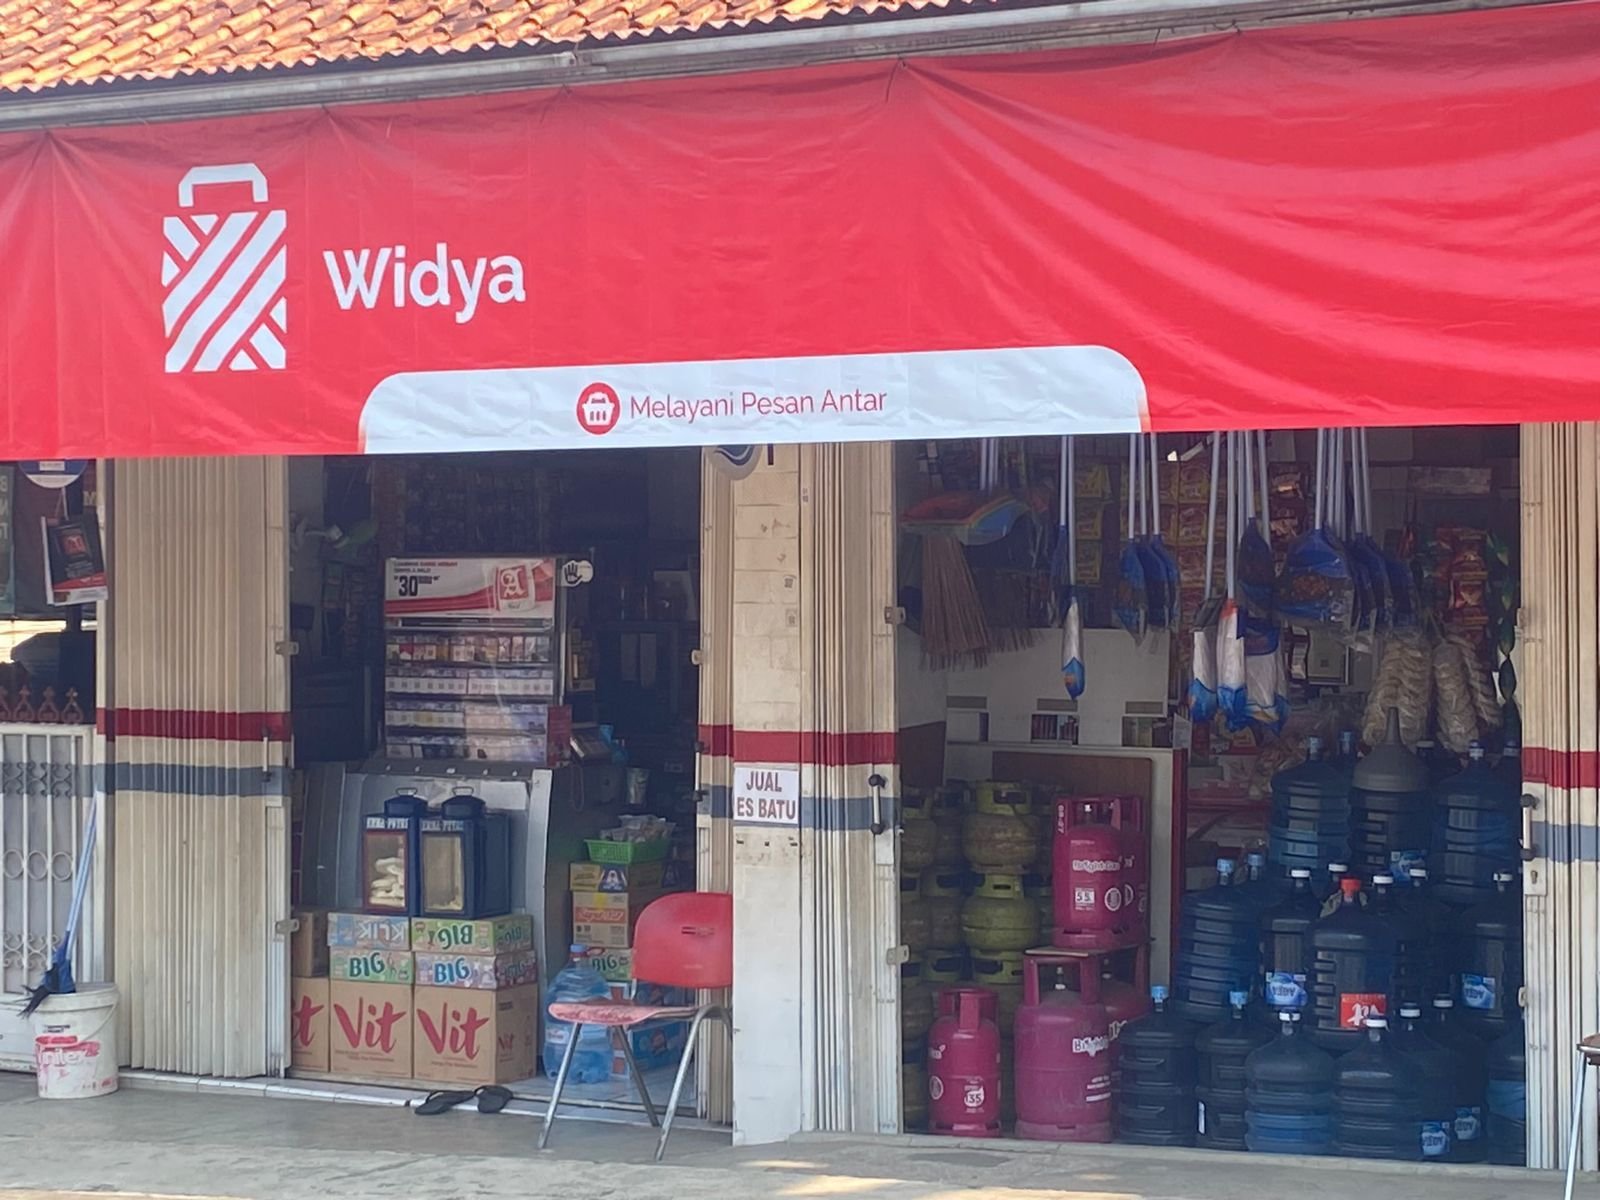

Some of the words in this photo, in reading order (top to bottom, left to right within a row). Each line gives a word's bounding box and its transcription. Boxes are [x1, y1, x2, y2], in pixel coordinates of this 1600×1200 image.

[322, 242, 526, 324] Widya
[629, 391, 735, 424] Melayani
[741, 391, 813, 416] Pesan
[821, 388, 888, 413] Antar
[398, 575, 419, 597] 30
[745, 770, 783, 793] JUAL
[736, 796, 754, 818] ES
[758, 798, 796, 820] BATU
[358, 918, 408, 941] KLIK
[437, 924, 474, 949] BIG
[349, 951, 386, 978] BIG
[433, 957, 471, 983] BIG
[333, 996, 407, 1054] Vit
[416, 1001, 490, 1060] Vit
